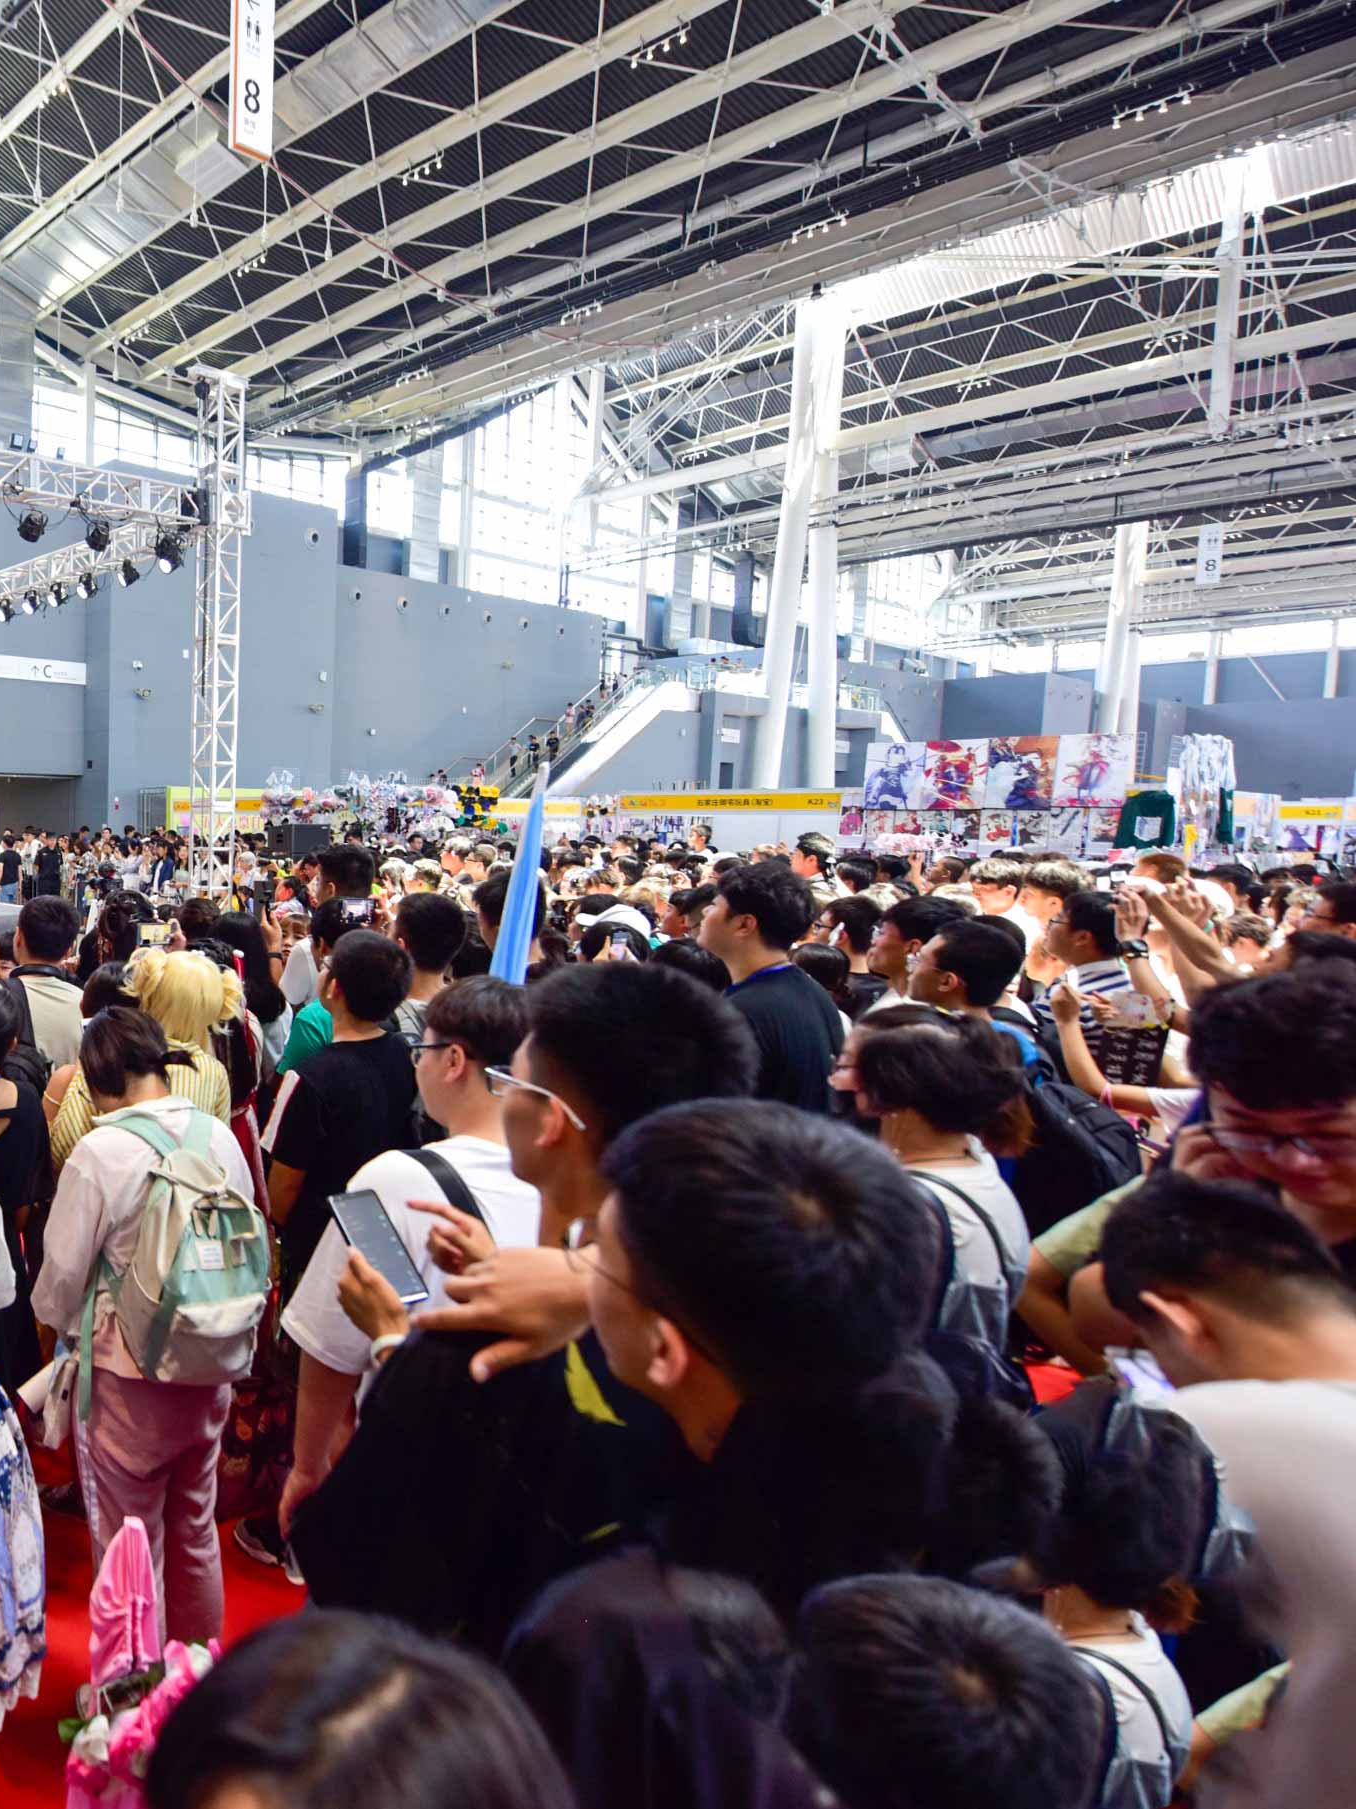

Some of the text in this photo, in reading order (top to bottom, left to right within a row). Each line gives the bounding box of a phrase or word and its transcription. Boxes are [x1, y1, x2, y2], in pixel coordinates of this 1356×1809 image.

[244, 79, 260, 114] 8
[1205, 559, 1216, 571] 8
[43, 664, 52, 679] C
